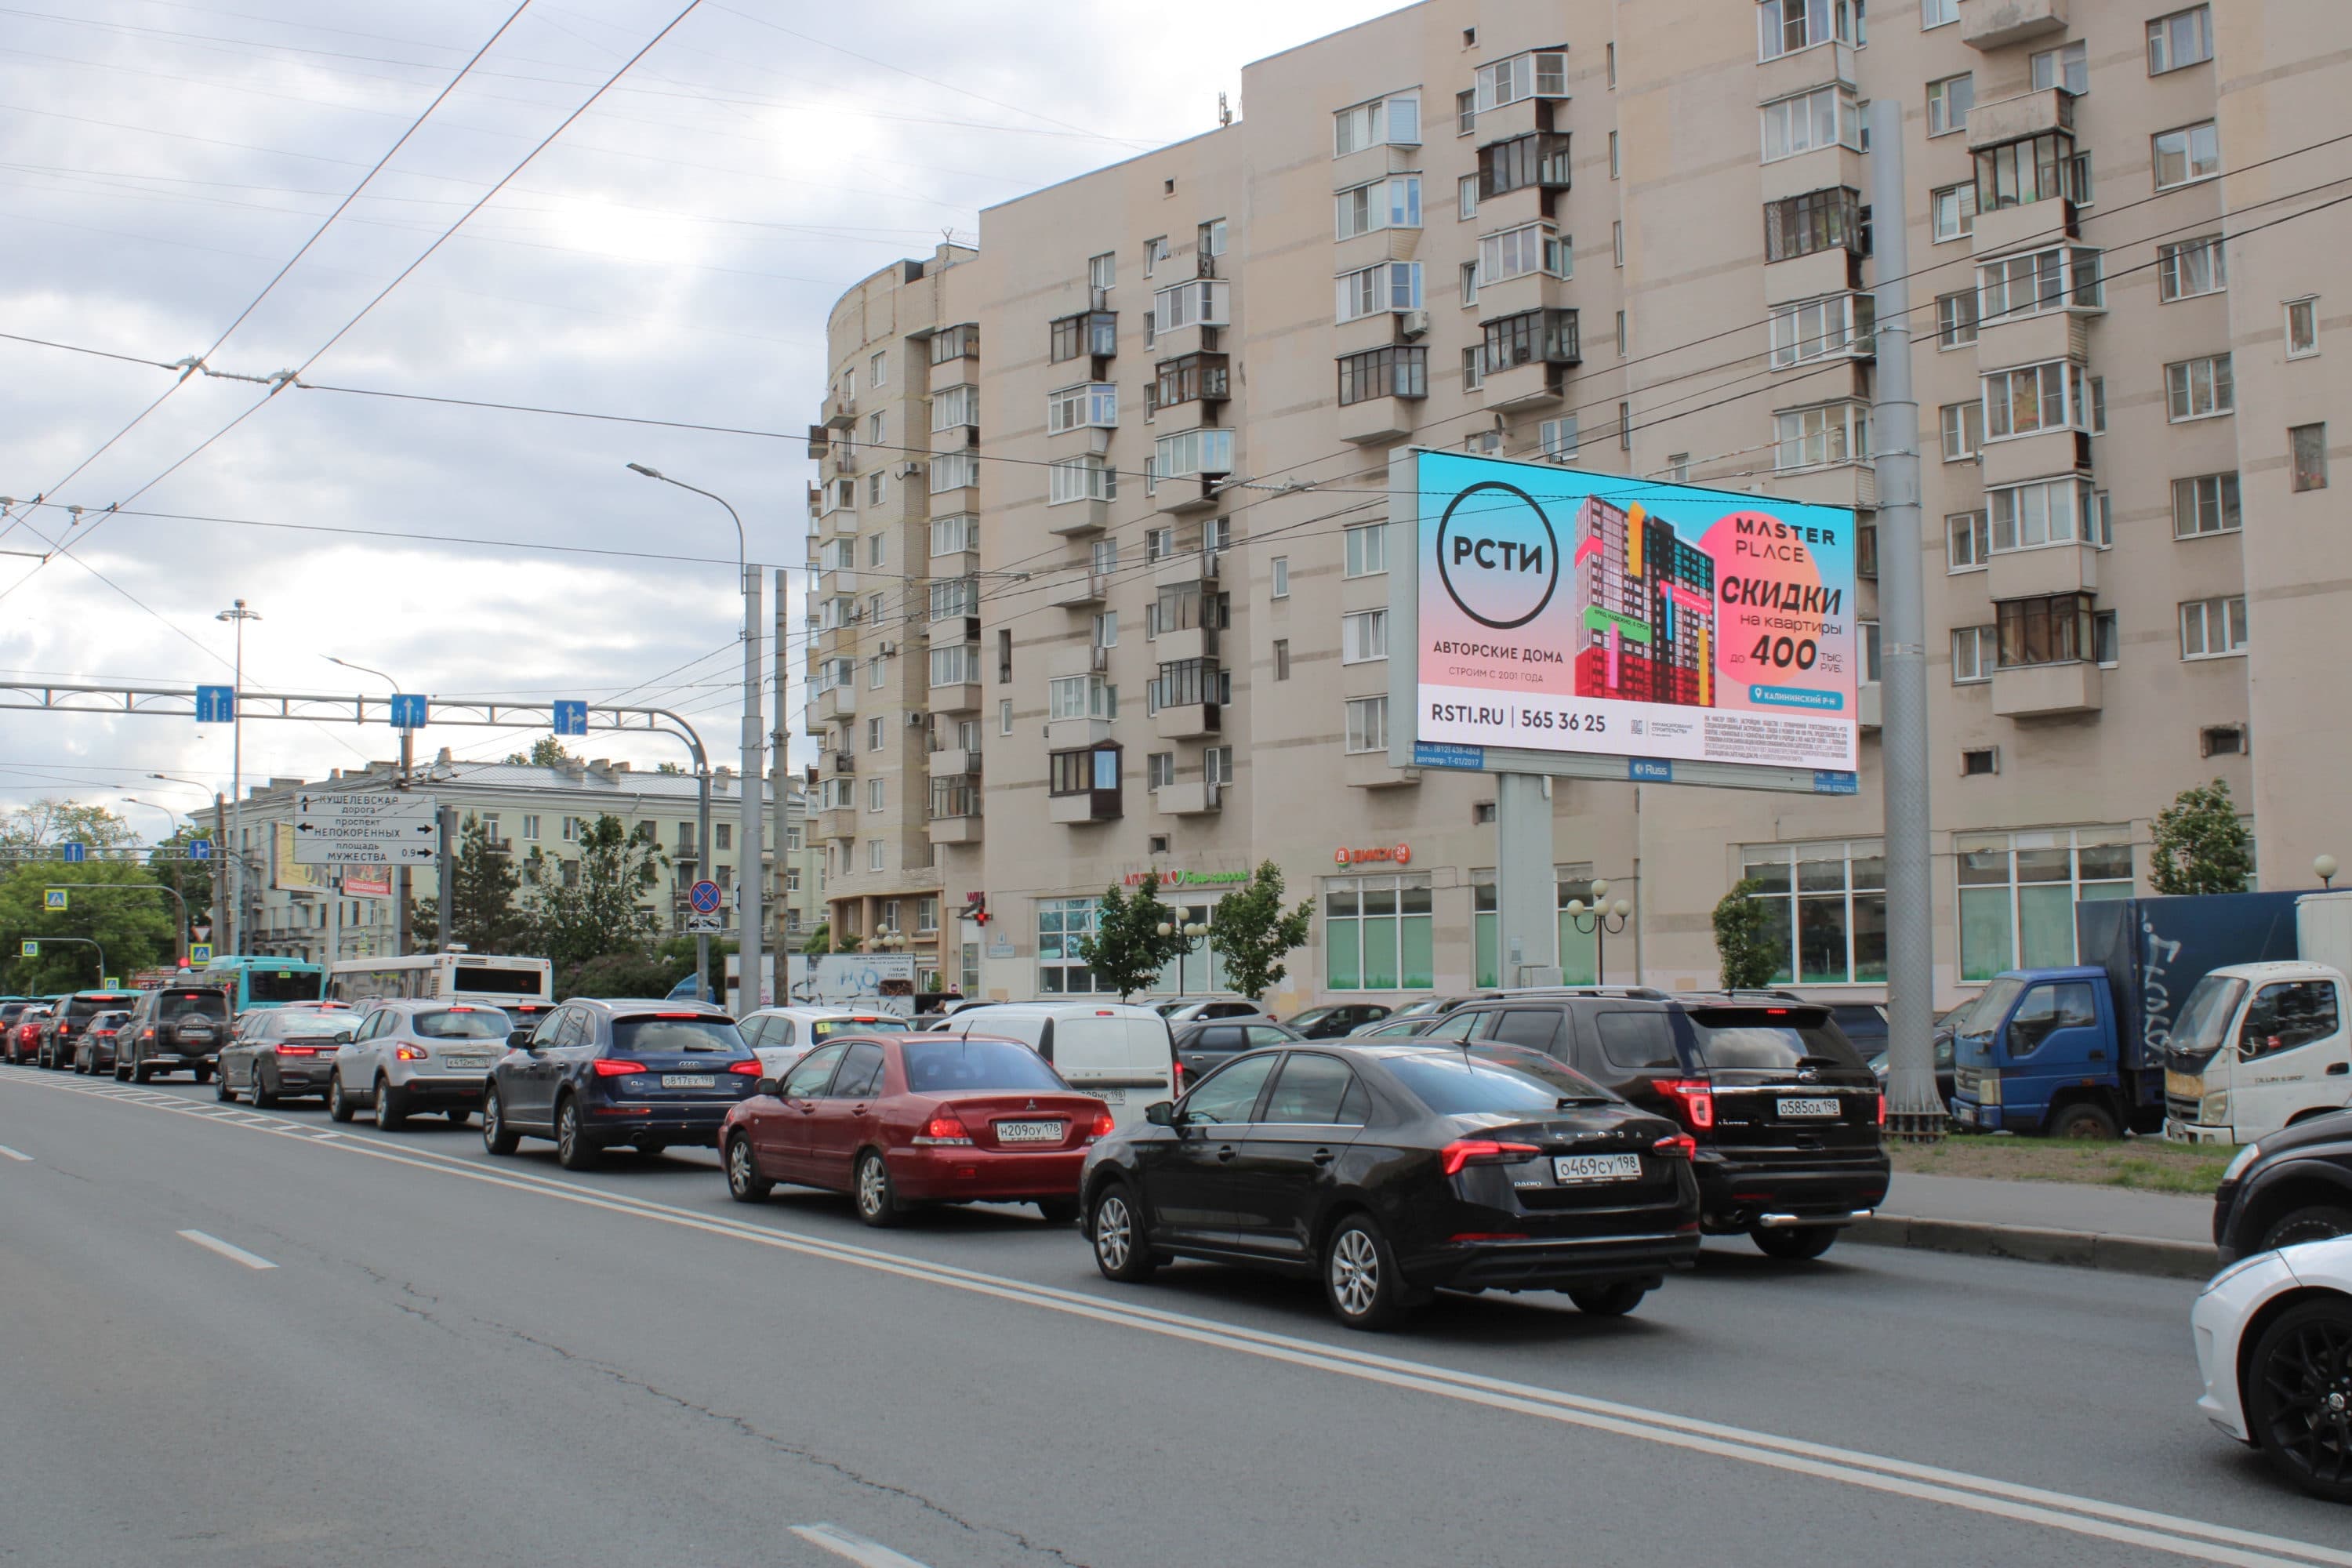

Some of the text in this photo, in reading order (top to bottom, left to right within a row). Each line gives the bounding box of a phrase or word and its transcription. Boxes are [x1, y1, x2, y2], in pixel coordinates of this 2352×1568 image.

[1736, 517, 1835, 546] MASTER
[1454, 535, 1543, 574] РСТИ
[1735, 539, 1804, 563] PLACE
[1721, 575, 1842, 615] СКИДКИ
[1740, 615, 1842, 637] на квартиры
[1433, 641, 1563, 664] АВТОРСКИЕ ДОМА
[1749, 634, 1817, 670] 400
[1449, 666, 1487, 677] СТРОИМ
[1498, 671, 1518, 681] 2001
[1520, 672, 1544, 682] ГОДА
[1764, 691, 1821, 704] КАЛИНИНСКИЙ
[1432, 703, 1606, 732] RSTI.RU 565 36 25
[1645, 764, 1668, 775] Russ
[319, 795, 399, 804] КУШЕЛЕВСКАЯ
[341, 806, 376, 815] дорога
[336, 818, 381, 827] проспект
[314, 828, 401, 837] НЕПОКОРЕННЫХ
[327, 852, 388, 861] МУЖЕСТВА
[401, 849, 416, 858] 0.9
[1823, 1100, 1838, 1110] 198
[1044, 1123, 1059, 1133] 178
[1617, 1156, 1637, 1168] 198
